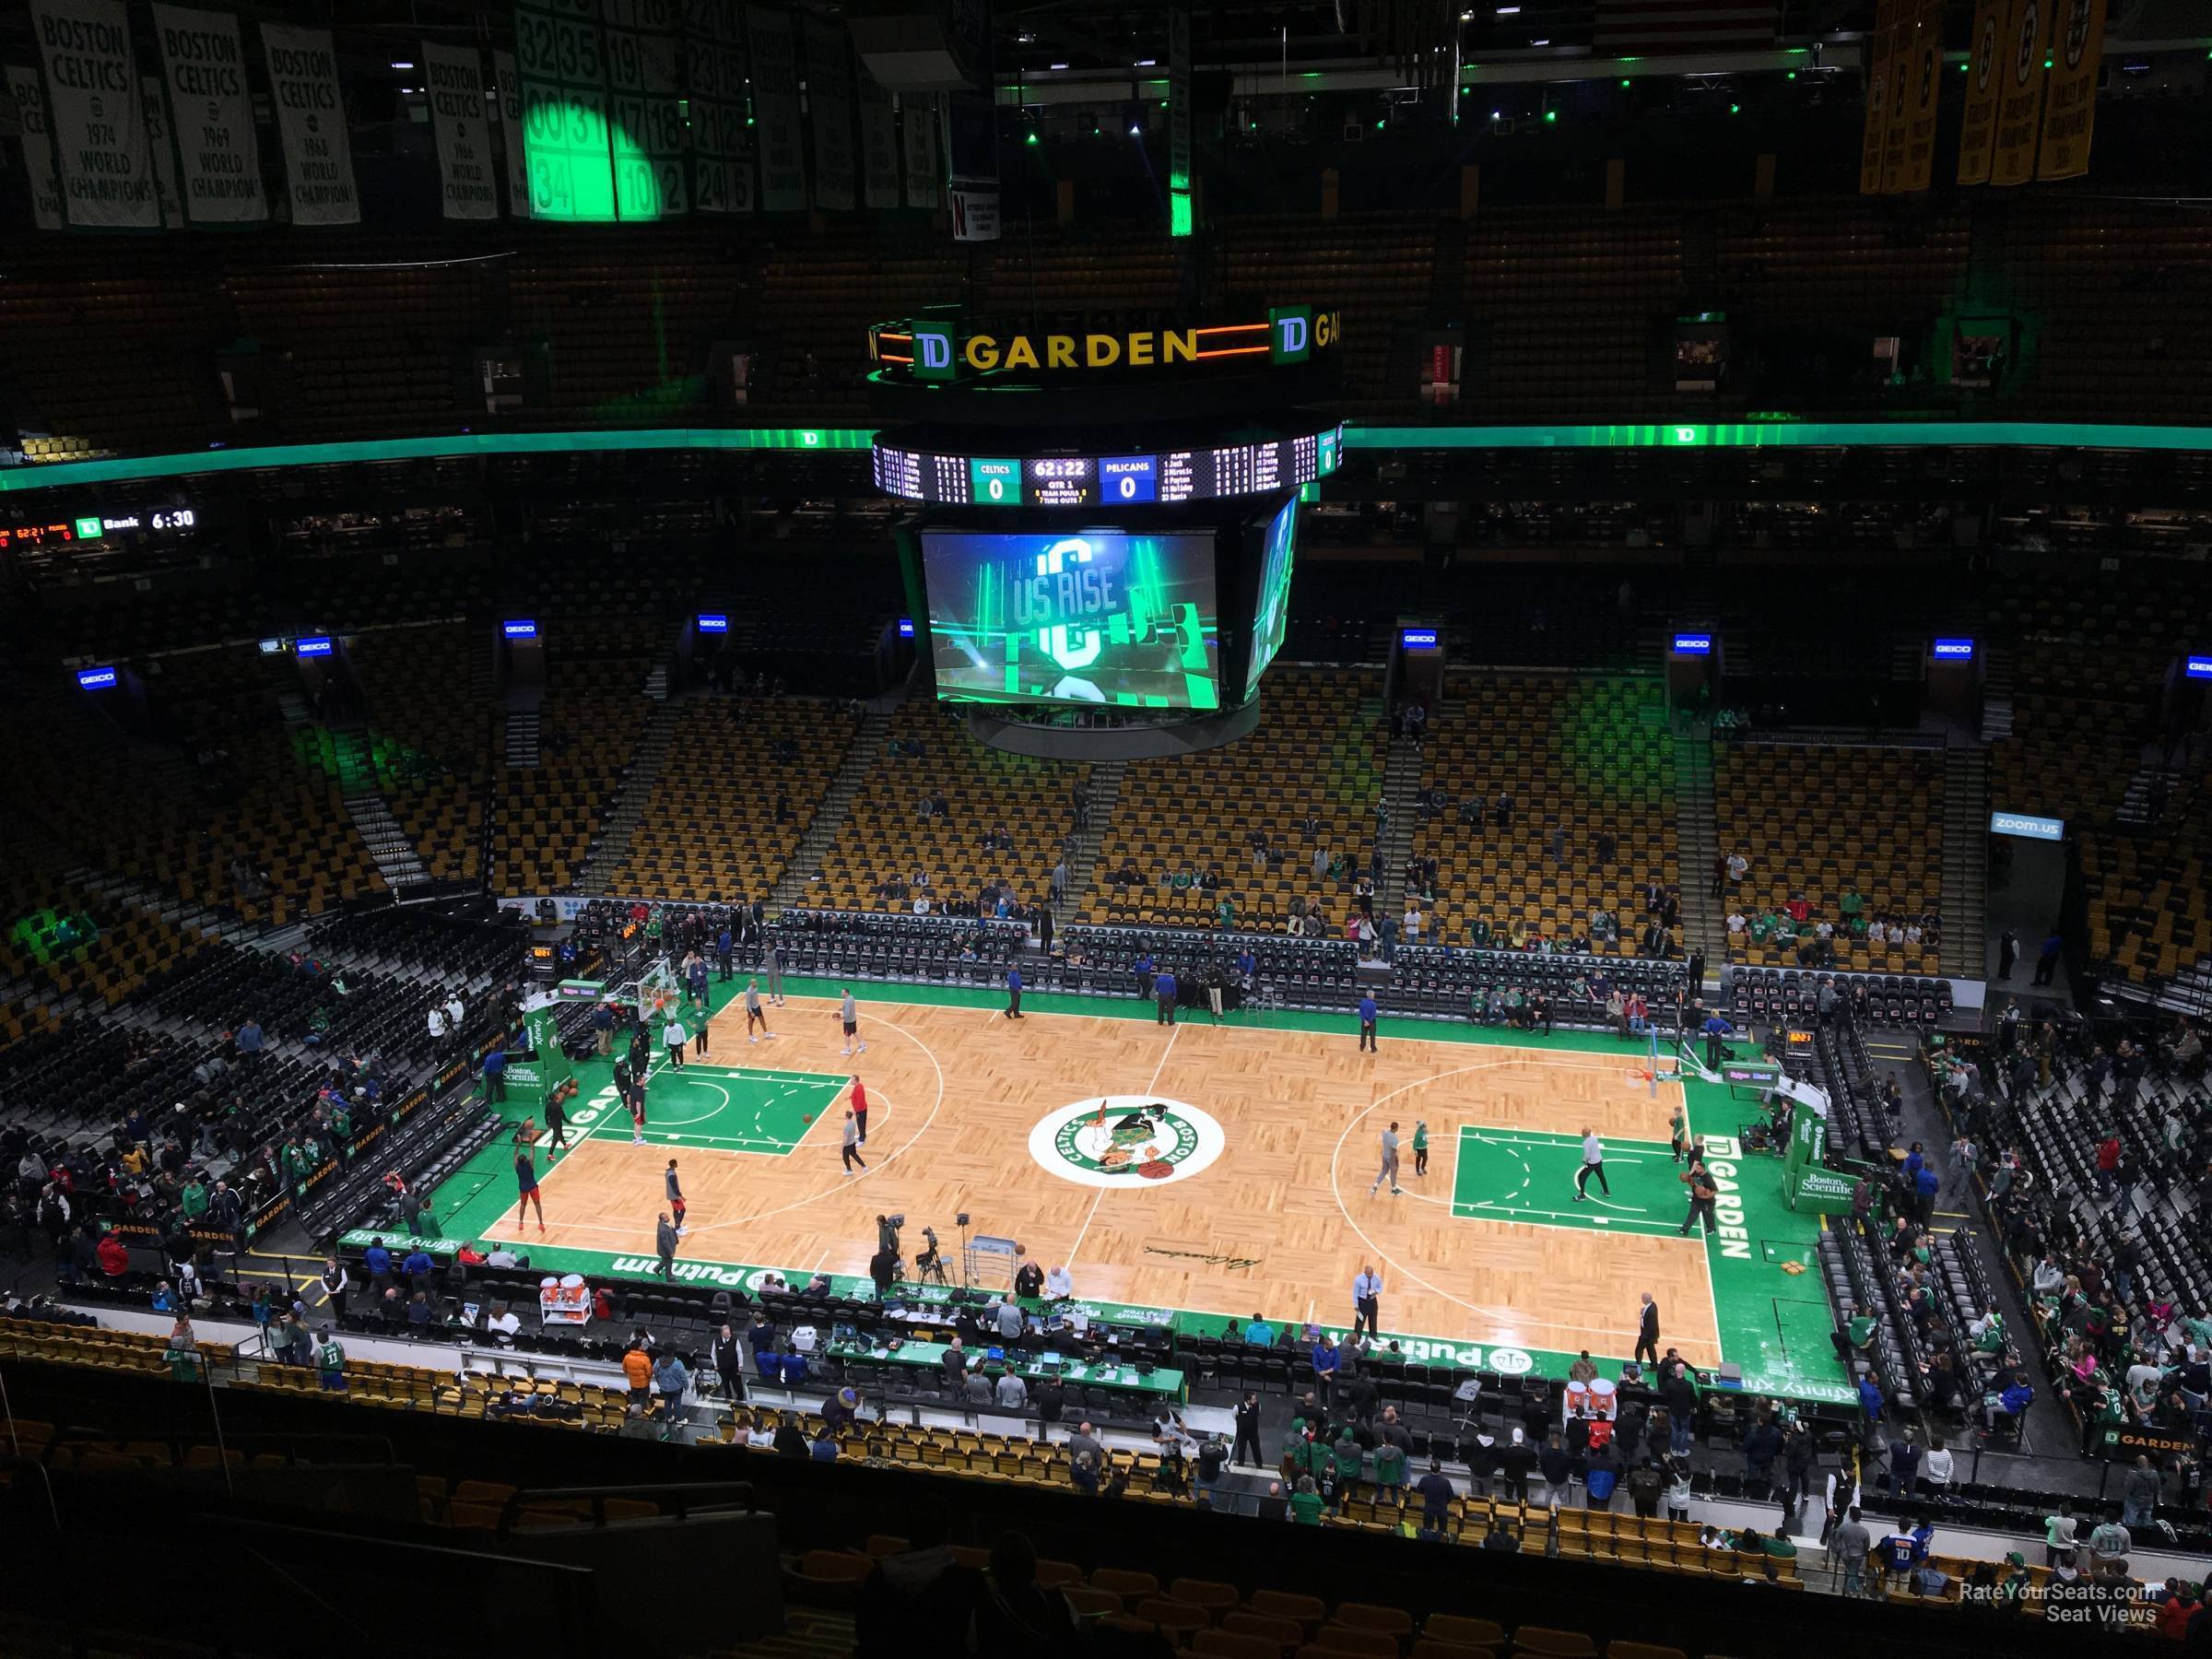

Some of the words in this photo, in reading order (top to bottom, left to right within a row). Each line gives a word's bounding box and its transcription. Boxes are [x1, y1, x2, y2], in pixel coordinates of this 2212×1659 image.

[41, 15, 126, 55] BOSTON
[165, 28, 237, 64] BOSTON
[519, 16, 555, 71] 32
[559, 26, 599, 78] 35
[611, 37, 638, 84] 19
[53, 53, 127, 92] CELTICS
[272, 47, 333, 78] BOSTON
[175, 65, 240, 97] CELTICS
[429, 62, 478, 90] BOSTON
[279, 81, 335, 110] CELTICS
[435, 91, 480, 119] CELTICS
[527, 89, 564, 142] 00
[569, 96, 605, 145] 31
[617, 100, 643, 147] 17
[652, 102, 680, 150] 18
[87, 123, 116, 146] 1974
[203, 126, 230, 148] 1969
[79, 150, 131, 174] WORLD
[198, 152, 243, 173] WORLD
[300, 161, 338, 181] WORLD
[451, 164, 481, 182] WORLD
[71, 178, 152, 201] CHAMPIONS
[535, 158, 571, 208] 34
[625, 165, 652, 212] 10
[663, 164, 681, 210] 2
[697, 163, 724, 207] 24
[734, 166, 747, 207] 6
[1277, 316, 1307, 353] TD
[915, 333, 950, 368] TD
[965, 328, 1197, 370] GARDEN
[981, 465, 1010, 475] CELTICS
[1035, 462, 1086, 477] 62:22
[1106, 463, 1150, 473] PELICANS
[1325, 450, 1332, 469] 0
[989, 478, 1004, 500] 0
[1048, 481, 1065, 489] QTR
[1067, 480, 1074, 489] 1
[1120, 477, 1136, 499] 0
[103, 516, 139, 530] Bank
[152, 510, 194, 530] 6:30
[17, 527, 44, 539] 62:21
[1014, 575, 1051, 625] US
[1058, 564, 1119, 617] RISE
[299, 641, 329, 653] GEICO
[1405, 635, 1435, 643] GEICO
[1676, 640, 1710, 648] GEICO
[1936, 645, 1971, 653] GEICO
[80, 672, 114, 685] GEICO
[2189, 663, 2212, 672] GEIC
[1995, 817, 2059, 834] zoom.us
[480, 1031, 504, 1053] GARDEN
[534, 1018, 544, 1046] xfinity
[441, 1060, 467, 1084] GARDEN
[502, 1071, 540, 1082] Scientific
[508, 1065, 531, 1075] Boston
[399, 1090, 428, 1115] GARDEN
[355, 1124, 384, 1149] GARDEN
[1056, 1118, 1086, 1162] CELTICS
[1164, 1120, 1195, 1164] BOSTON
[1813, 1134, 1823, 1160] Putnam
[306, 1159, 338, 1187] GARDEN
[1809, 1173, 1842, 1186] Boston
[1802, 1179, 1854, 1195] Scientific
[256, 1198, 290, 1228] GARDEN
[1708, 1160, 1752, 1260] GARDEN
[113, 1224, 159, 1235] GARDEN
[328, 1353, 338, 1365] 11
[1783, 1382, 1857, 1401] xfinity
[2113, 1403, 2121, 1415] 0
[1895, 1548, 1910, 1561] 10
